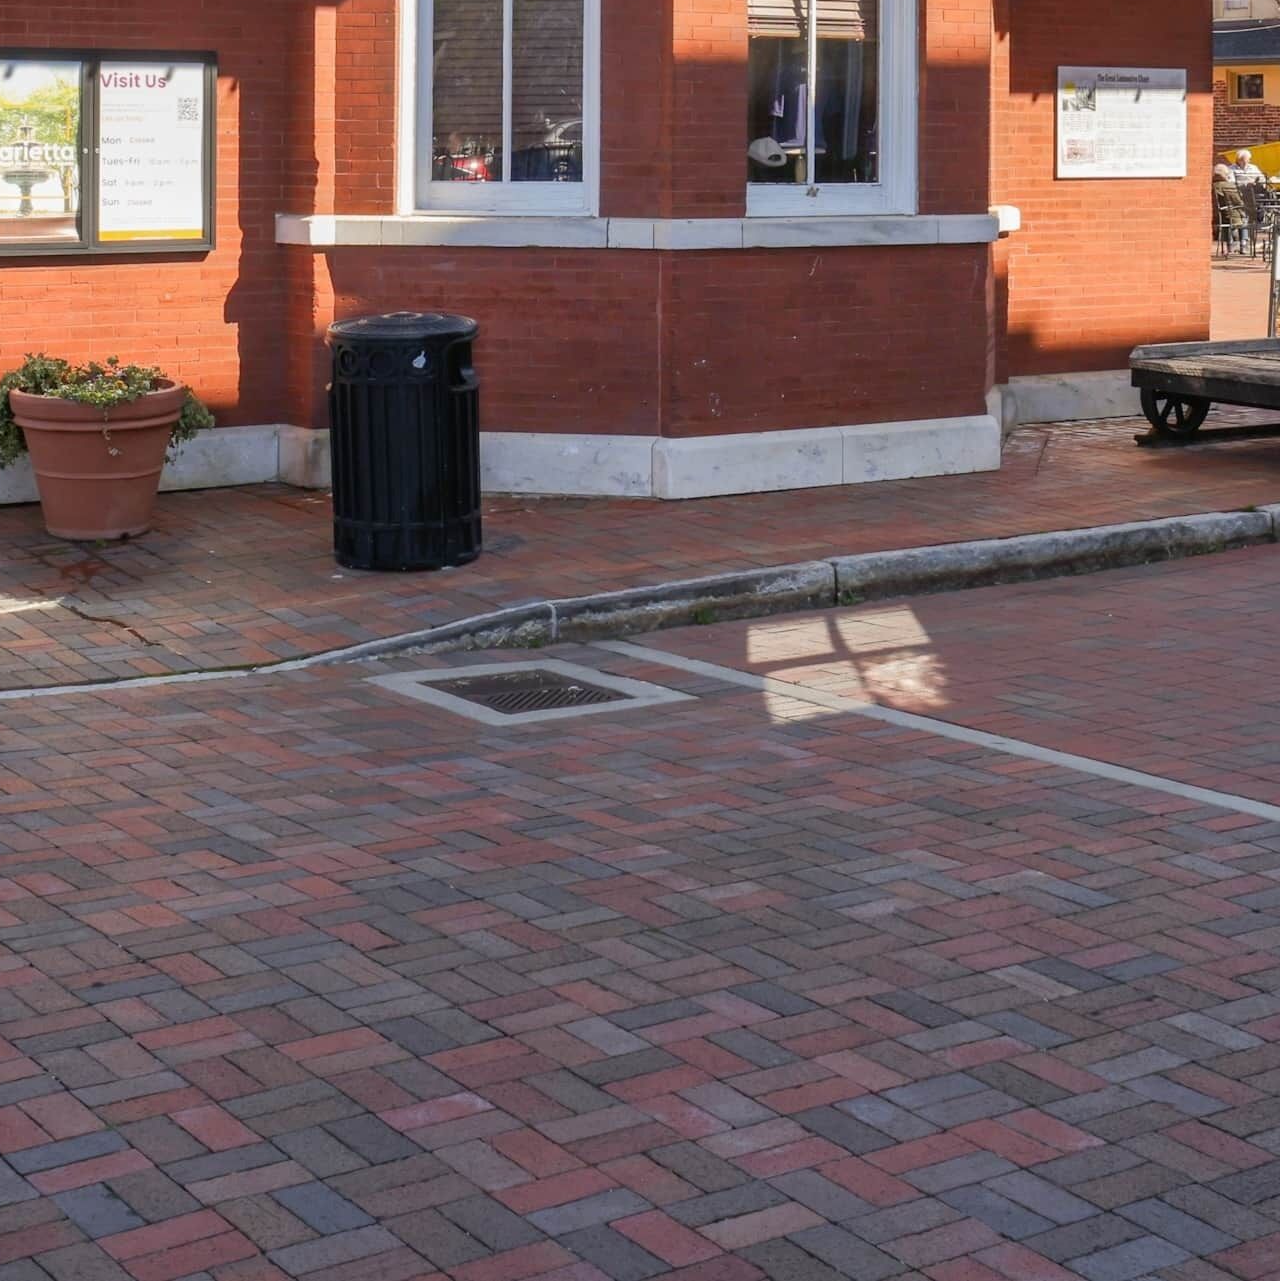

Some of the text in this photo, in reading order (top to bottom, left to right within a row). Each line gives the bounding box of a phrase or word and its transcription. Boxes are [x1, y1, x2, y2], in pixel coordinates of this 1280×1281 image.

[101, 72, 167, 89] Visit Us
[101, 136, 122, 145] Mon
[102, 177, 118, 187] Sat
[102, 198, 121, 208] Sun
